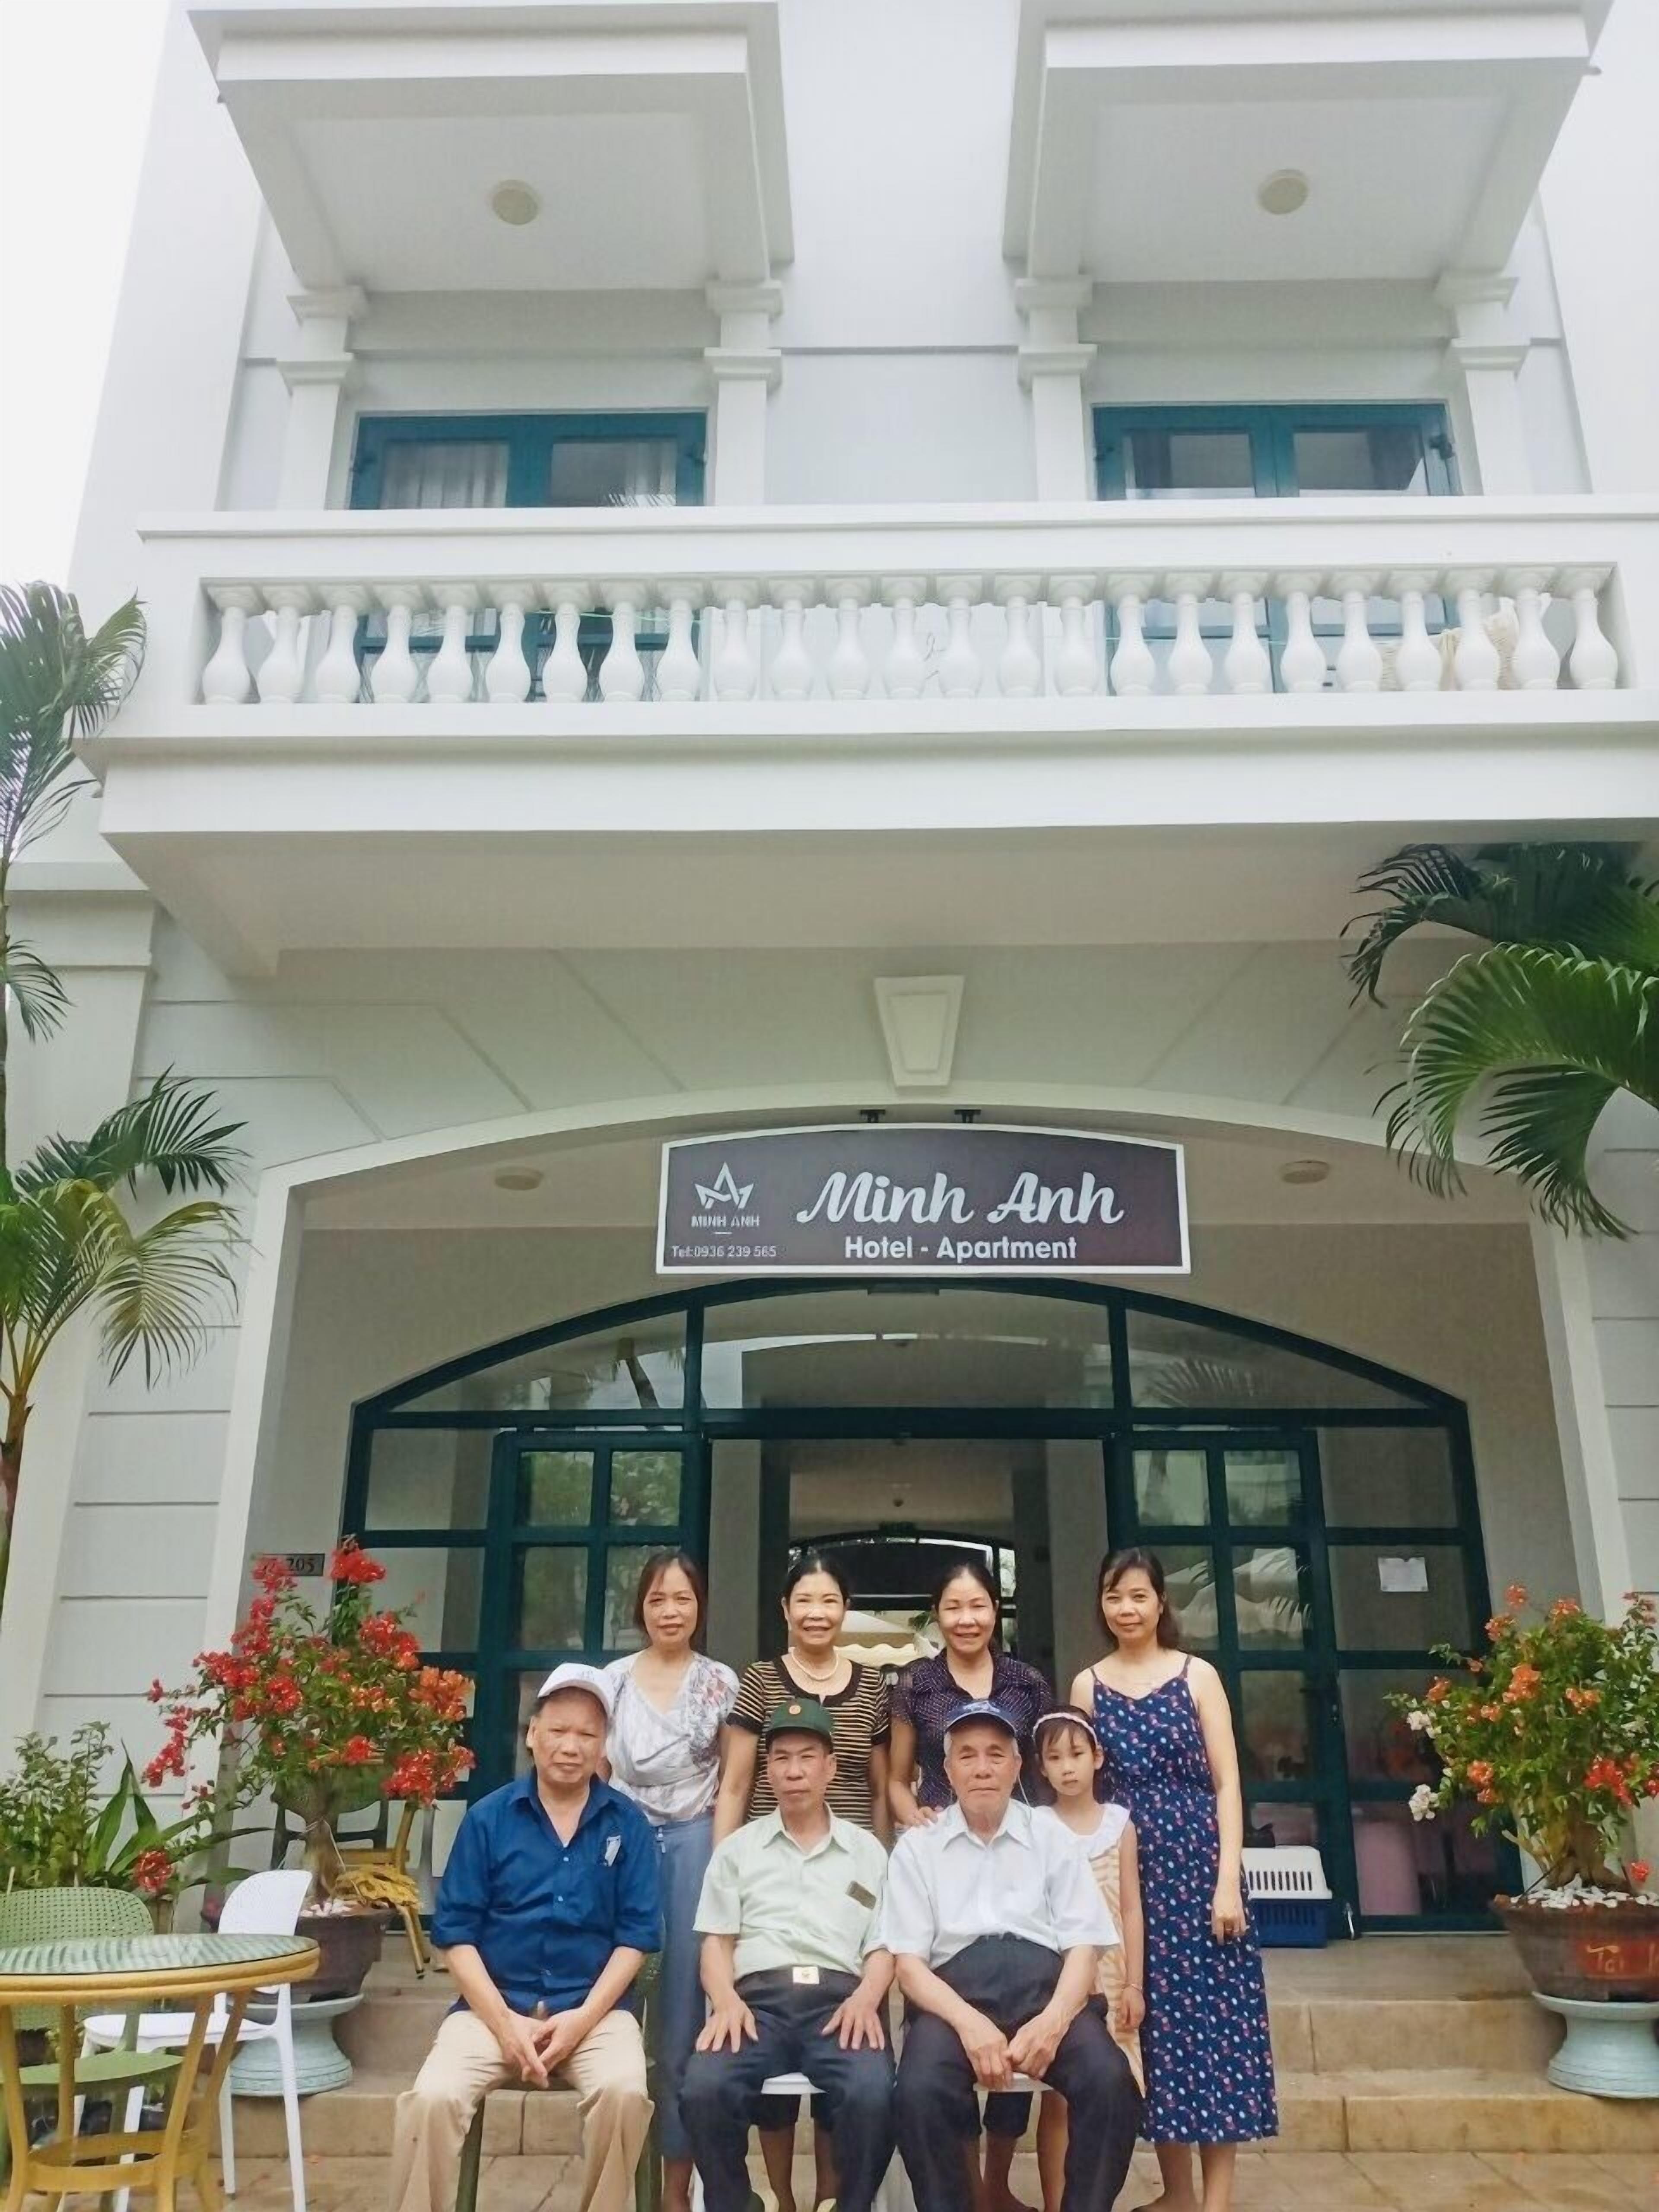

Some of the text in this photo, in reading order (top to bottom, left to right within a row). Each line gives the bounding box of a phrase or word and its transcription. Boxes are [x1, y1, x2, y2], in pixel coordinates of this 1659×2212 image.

[796, 1171, 1124, 1224] Minh Anh
[691, 1215, 760, 1228] MINH ANH
[727, 1245, 751, 1257] 239
[753, 1245, 777, 1257] 565
[845, 1236, 912, 1259] Hotel
[937, 1236, 1077, 1263] Apartment
